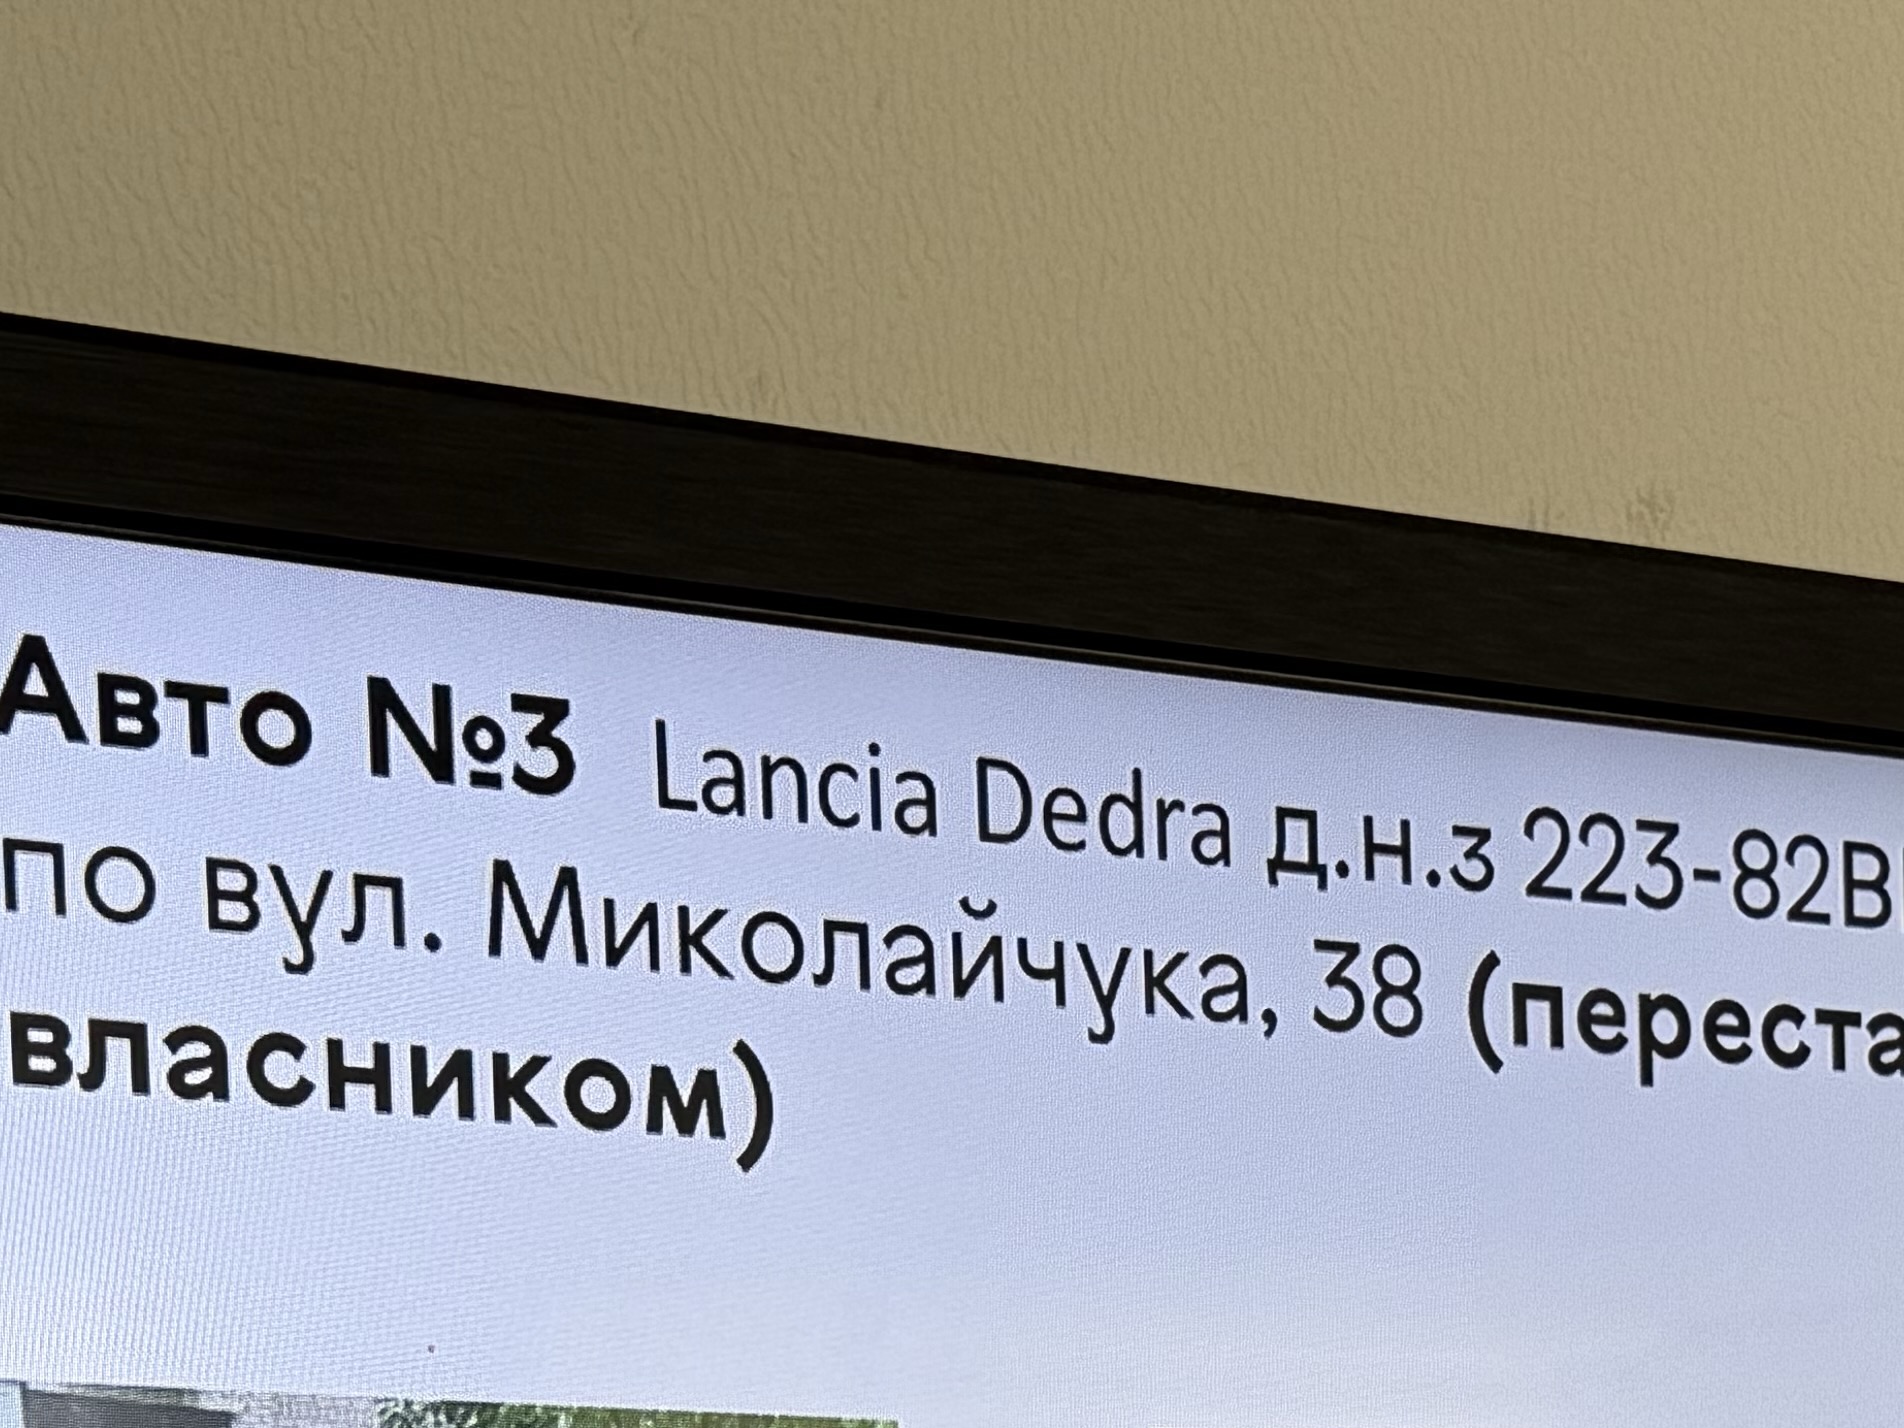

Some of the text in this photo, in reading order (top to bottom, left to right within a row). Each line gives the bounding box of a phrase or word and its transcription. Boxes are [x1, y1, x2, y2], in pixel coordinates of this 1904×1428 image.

[365, 674, 577, 798] №3
[654, 718, 939, 838] Lancia
[975, 755, 1233, 868] Dedra
[1265, 804, 1496, 894] д.н.з
[1, 836, 157, 925] по
[204, 856, 442, 976] вул.
[487, 858, 1279, 1046] Миколайчука,
[1312, 937, 1425, 1040] 38
[9, 1010, 775, 1173] власником)
